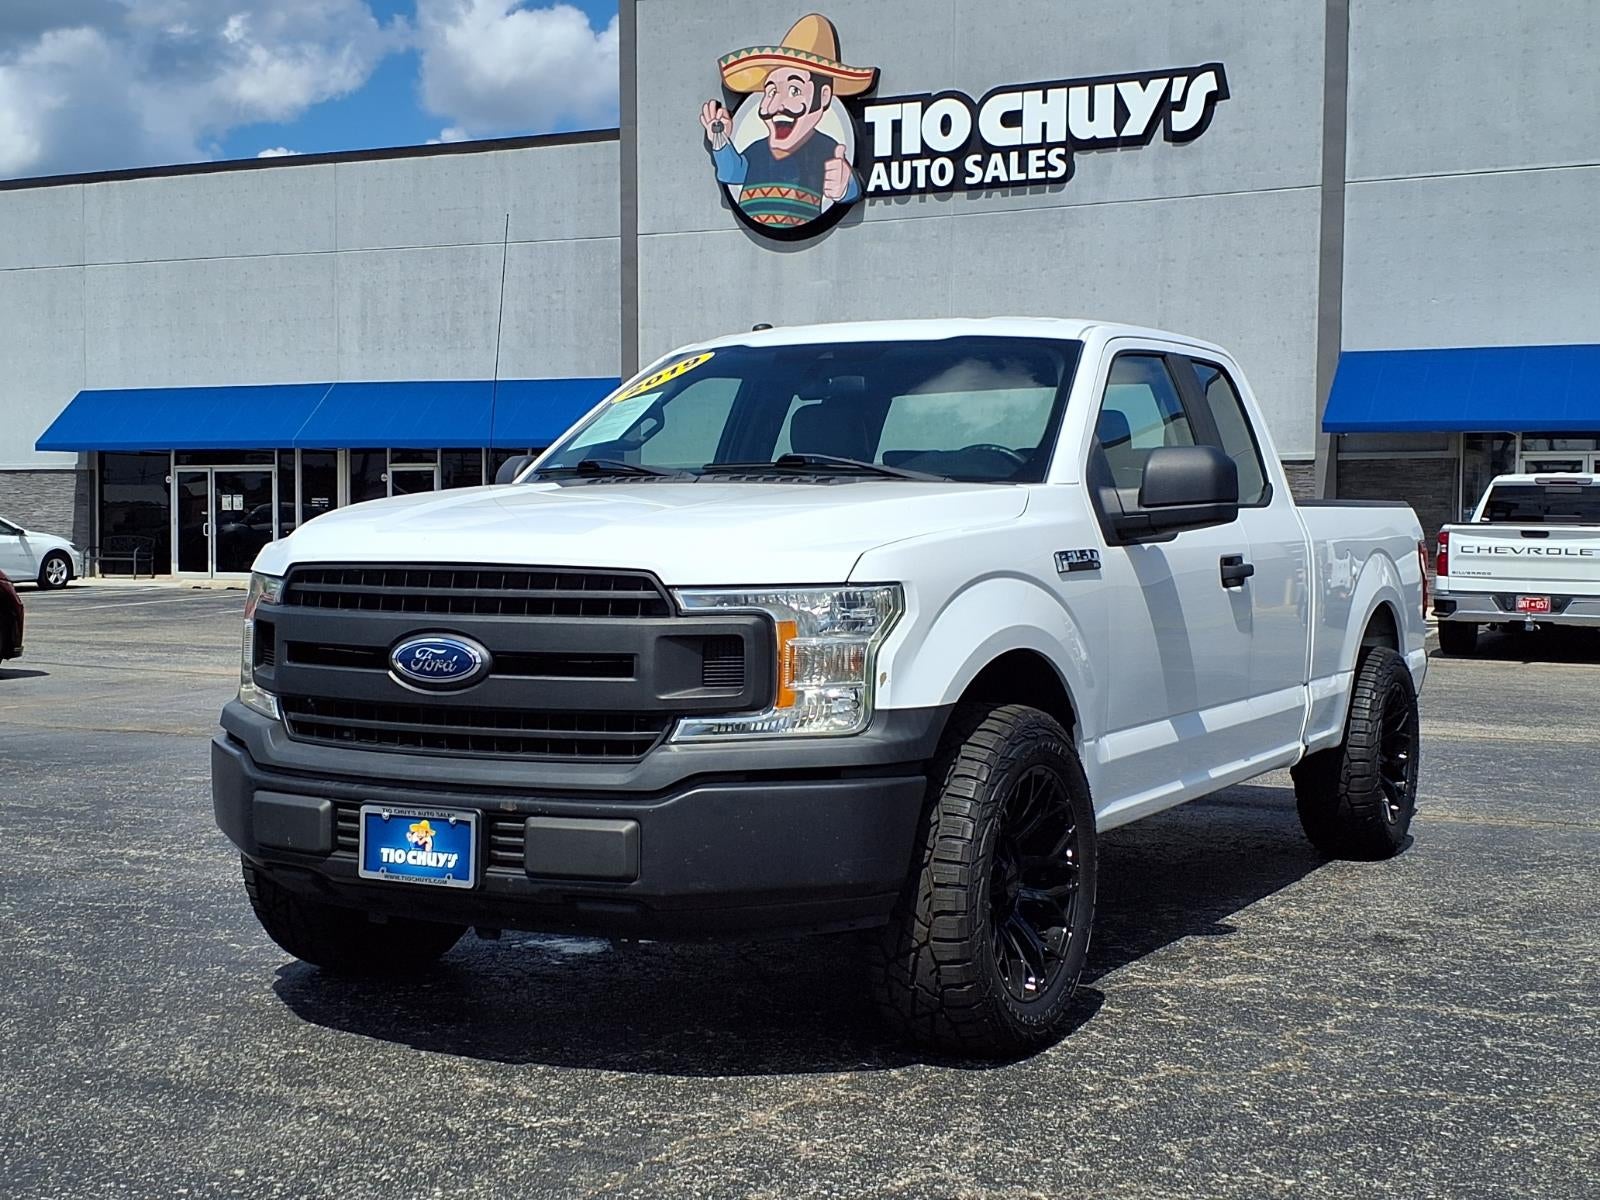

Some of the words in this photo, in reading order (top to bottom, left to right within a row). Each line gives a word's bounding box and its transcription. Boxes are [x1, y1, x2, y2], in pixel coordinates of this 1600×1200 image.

[864, 97, 972, 157] TIO
[978, 70, 1218, 147] CHUY'S
[866, 156, 955, 192] AUTO
[964, 148, 1067, 185] SALES
[625, 357, 701, 397] 2019
[1054, 550, 1100, 572] F-150
[1460, 545, 1600, 556] CHEVROLE
[410, 647, 458, 672] Ford
[380, 847, 406, 864] TIO
[407, 850, 458, 868] CHUY'S
